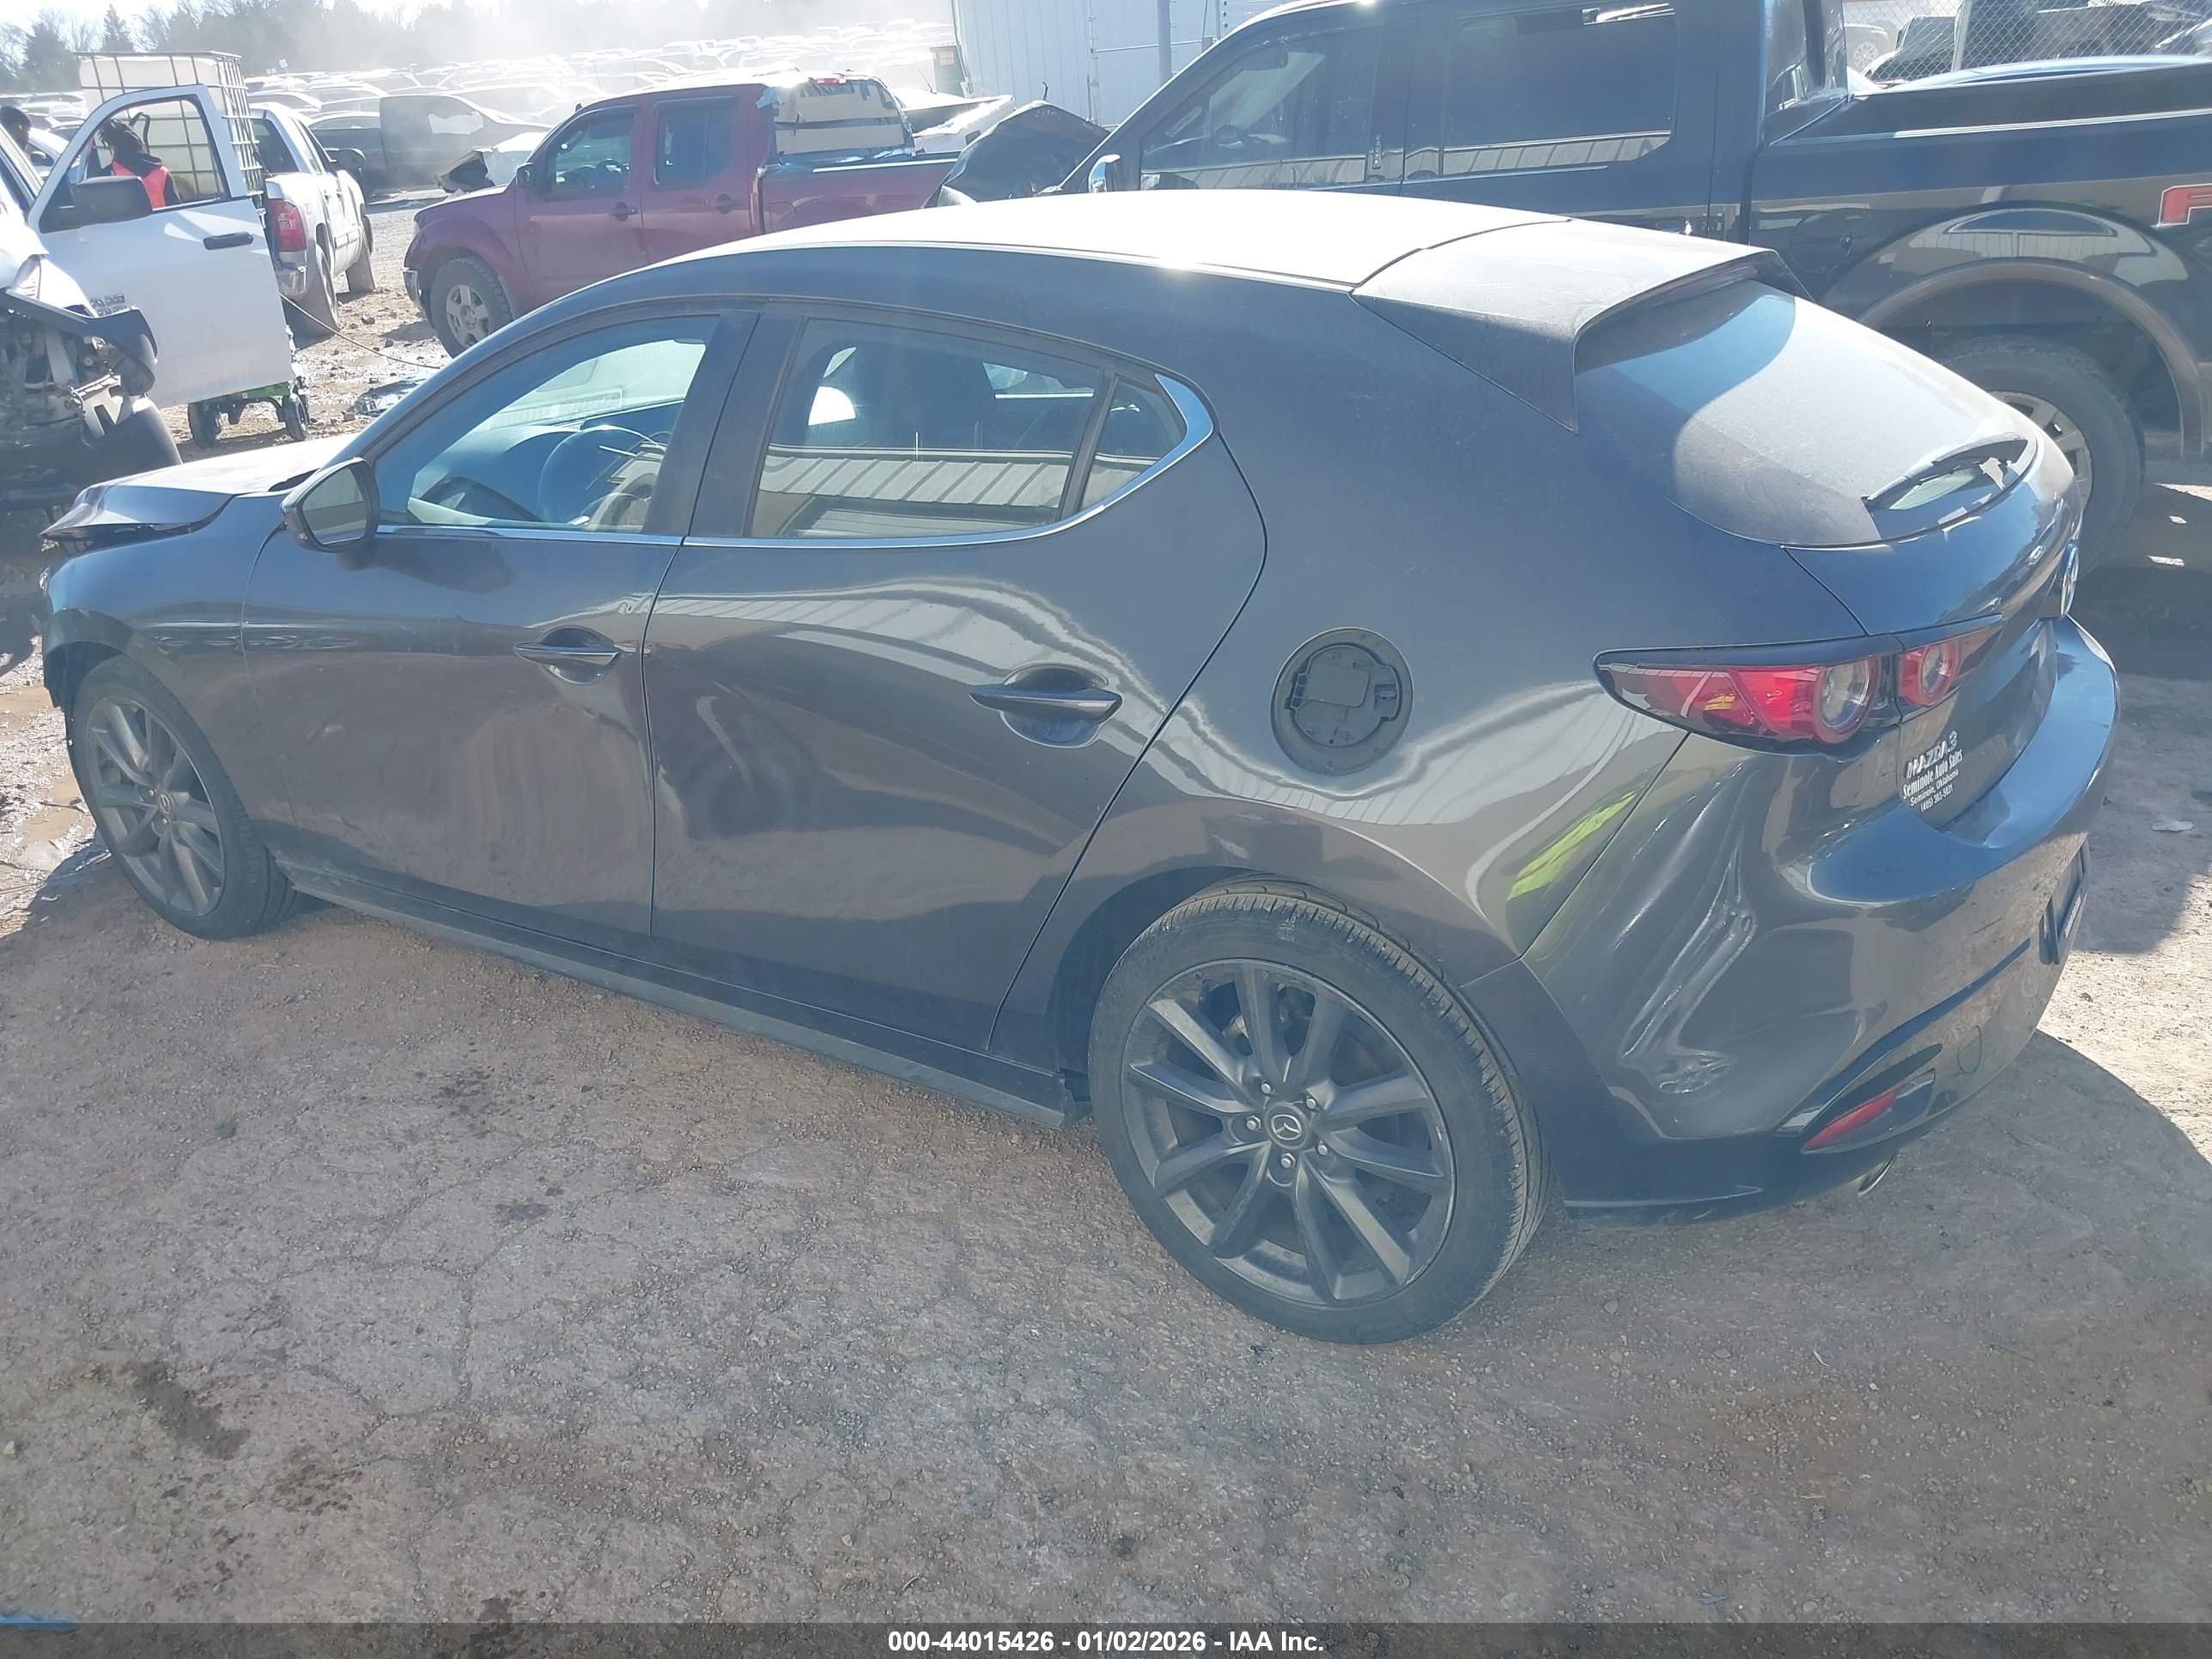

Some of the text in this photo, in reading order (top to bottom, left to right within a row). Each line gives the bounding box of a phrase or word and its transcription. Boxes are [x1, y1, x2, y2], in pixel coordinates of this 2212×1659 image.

[1903, 749, 1963, 799] Seminole Auto Sales
[1936, 769, 1959, 789] Oklahoma
[1920, 796, 1934, 812] (405)
